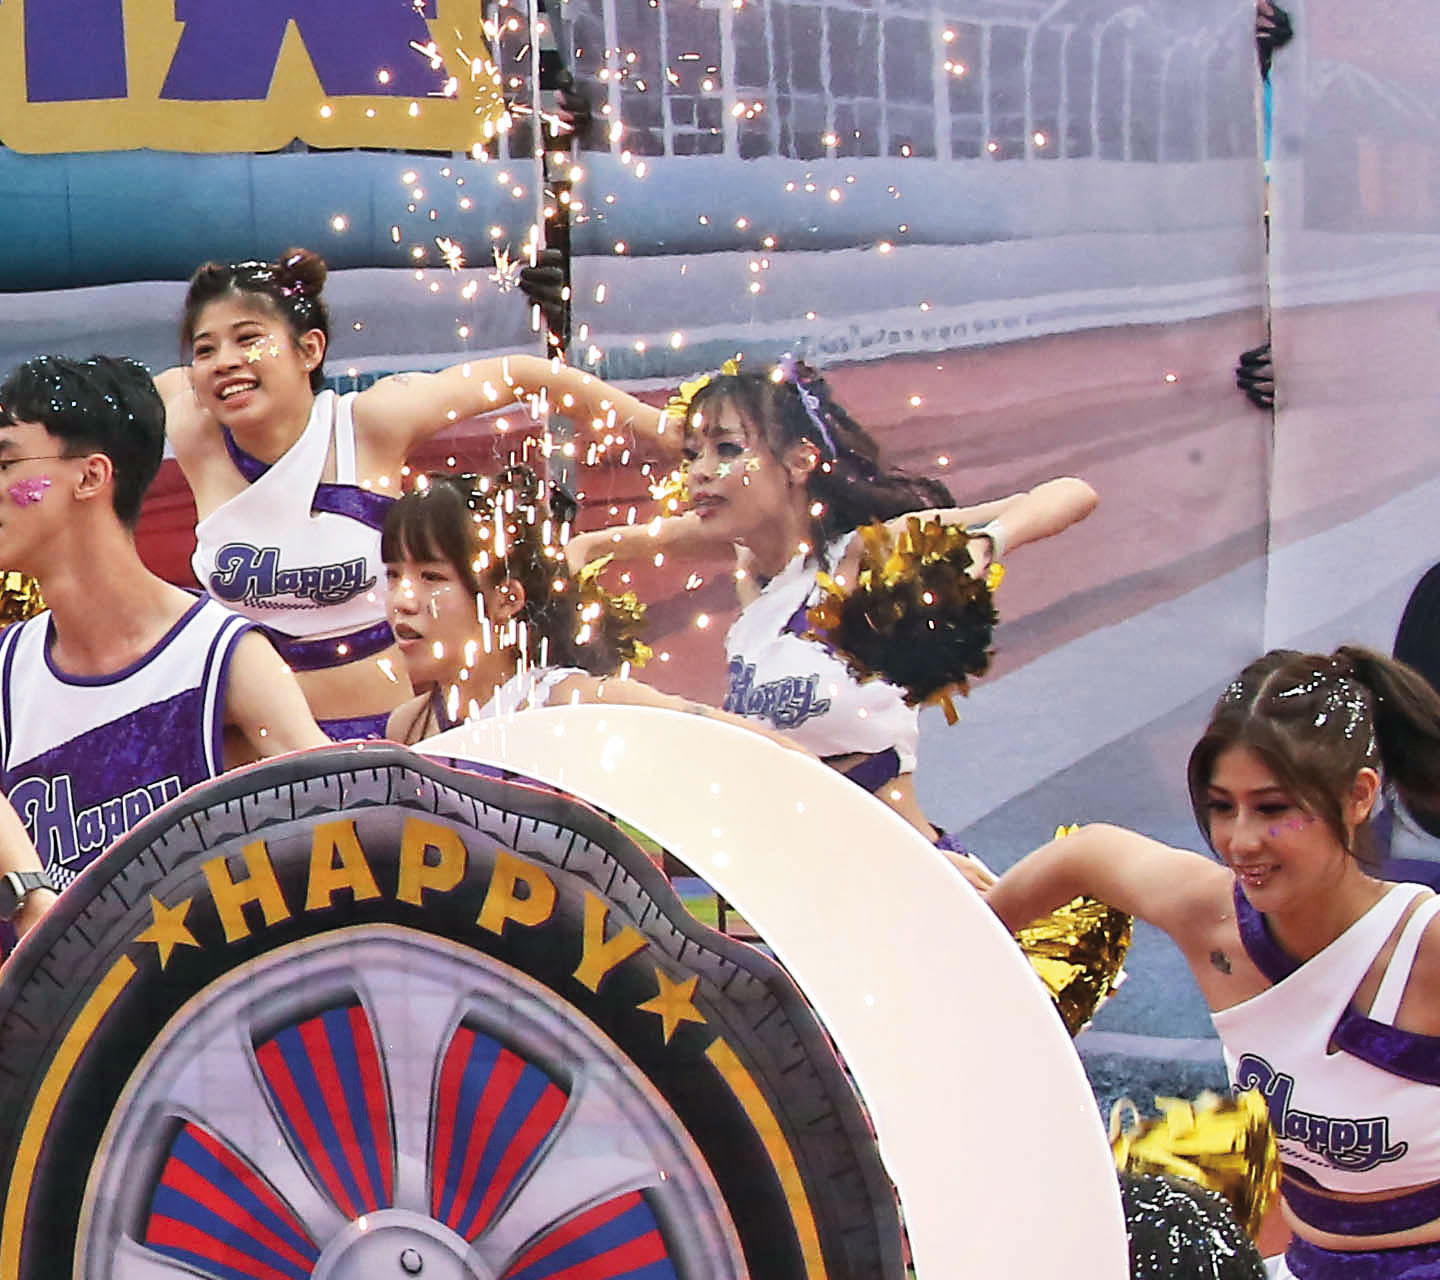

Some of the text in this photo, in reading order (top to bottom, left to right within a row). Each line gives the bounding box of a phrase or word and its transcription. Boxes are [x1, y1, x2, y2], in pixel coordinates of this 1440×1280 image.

[211, 543, 377, 605] Happy
[724, 654, 830, 729] Happy
[199, 815, 650, 995] HAPPY
